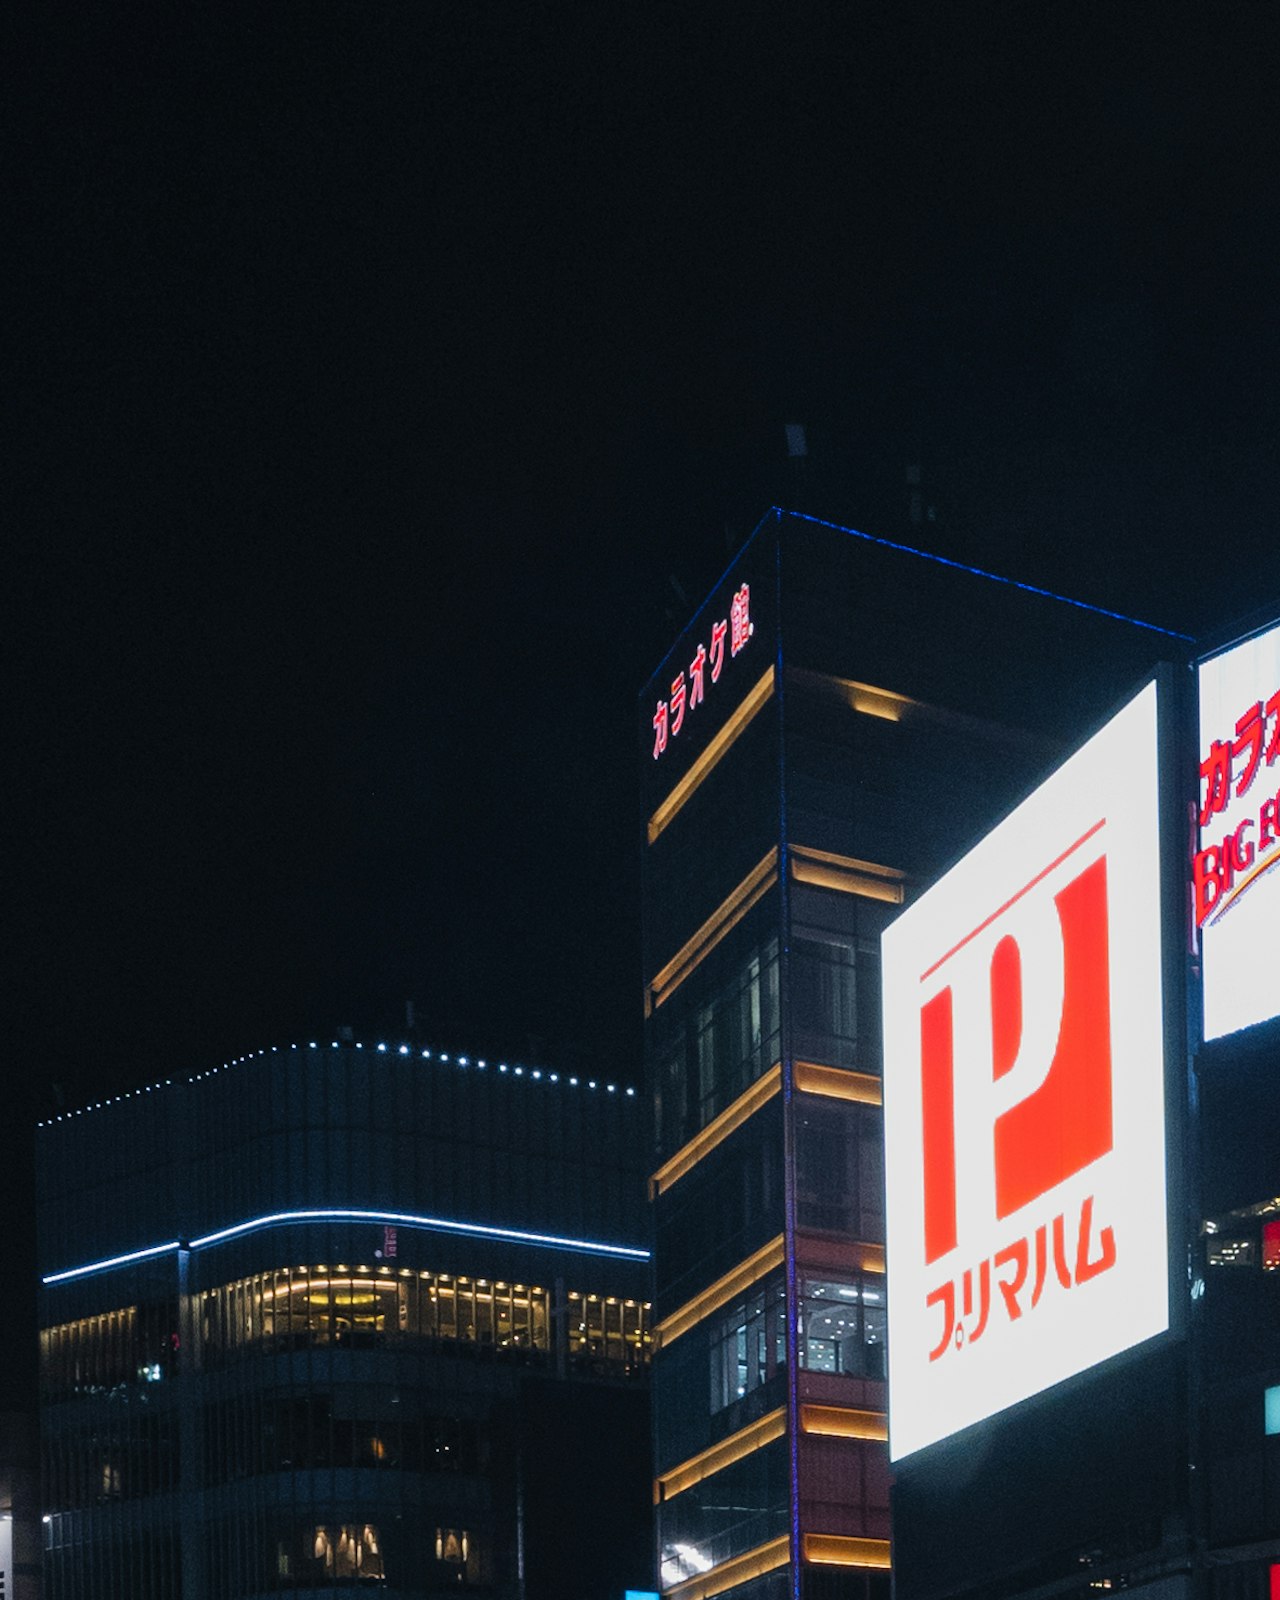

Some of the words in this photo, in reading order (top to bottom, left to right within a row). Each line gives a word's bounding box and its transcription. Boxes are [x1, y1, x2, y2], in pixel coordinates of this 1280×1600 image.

[652, 584, 753, 760] カラオケ館
[1193, 818, 1257, 928] BIG
[926, 1194, 1117, 1363] プリマハム
